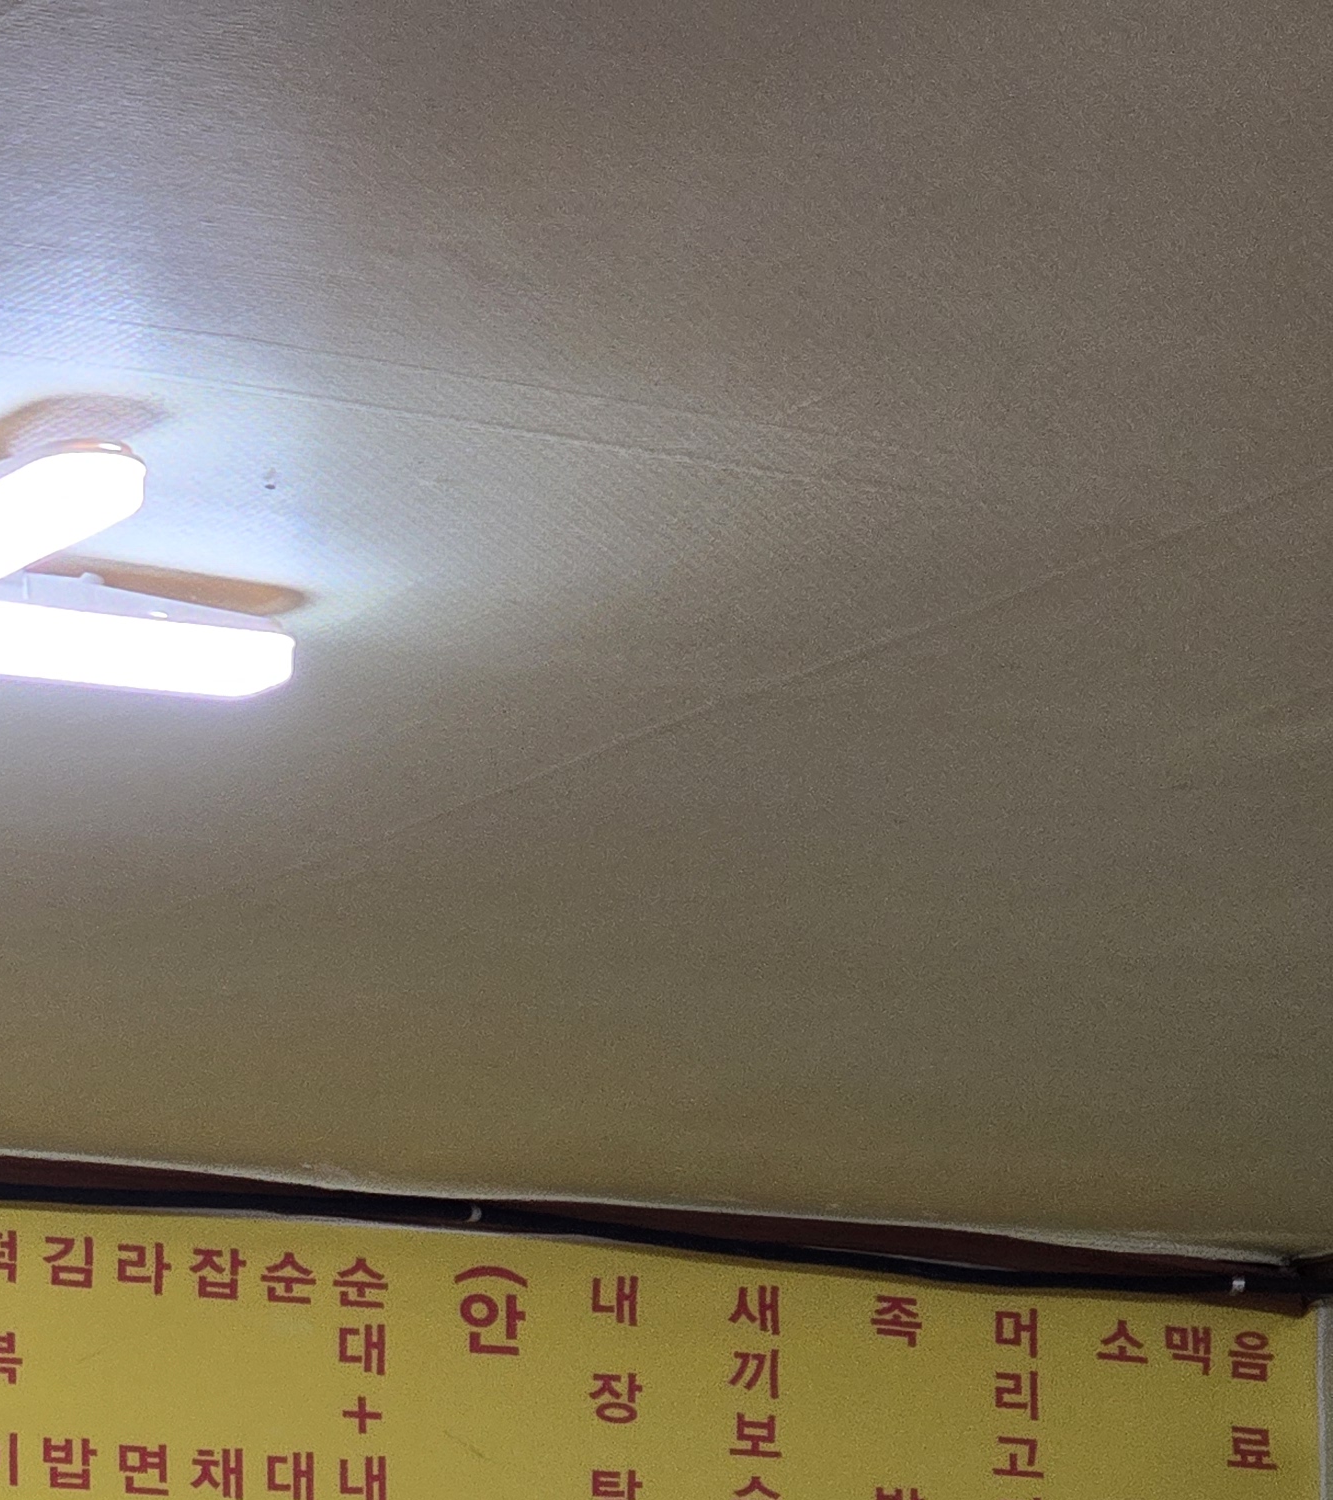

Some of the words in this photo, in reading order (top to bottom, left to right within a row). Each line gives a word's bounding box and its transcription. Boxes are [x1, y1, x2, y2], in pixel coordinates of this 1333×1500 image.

[43, 1236, 97, 1490] 김밥
[117, 1242, 172, 1496] 라면
[189, 1247, 247, 1500] 잡채
